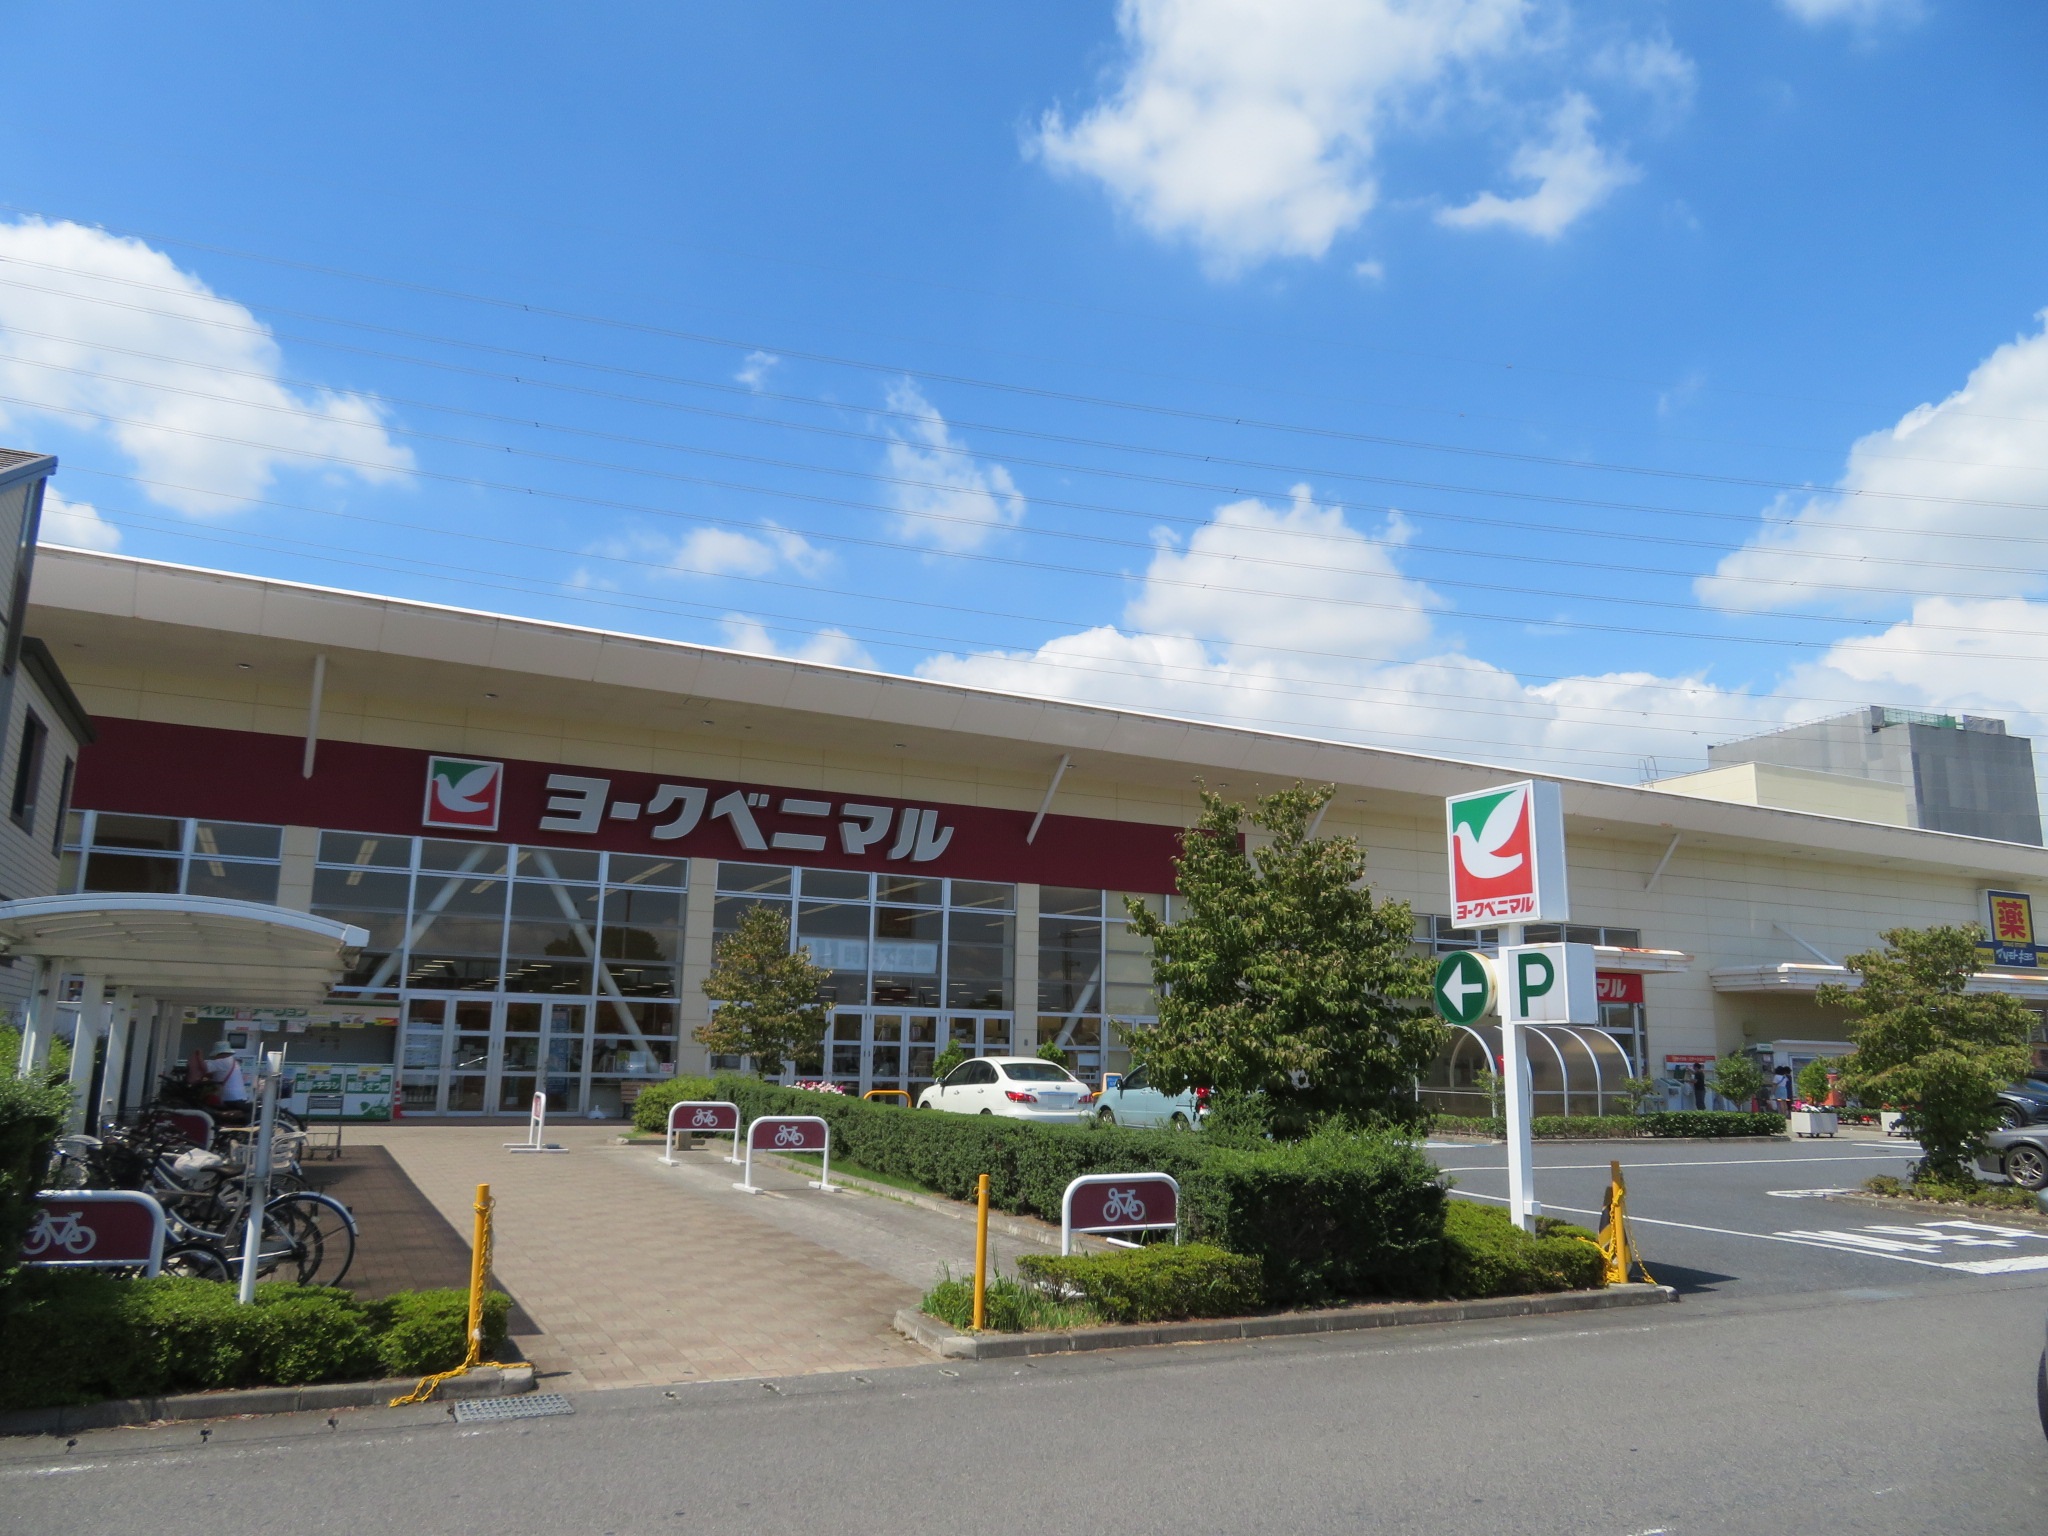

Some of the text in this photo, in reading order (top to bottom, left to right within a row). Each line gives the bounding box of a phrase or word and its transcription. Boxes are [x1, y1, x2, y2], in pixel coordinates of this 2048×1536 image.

[538, 774, 955, 862] ヨークベニマル
[1456, 897, 1534, 920] ヨークベニマル
[1996, 900, 2027, 938] 薬
[1518, 953, 1554, 1017] P
[1597, 978, 1627, 998] マル
